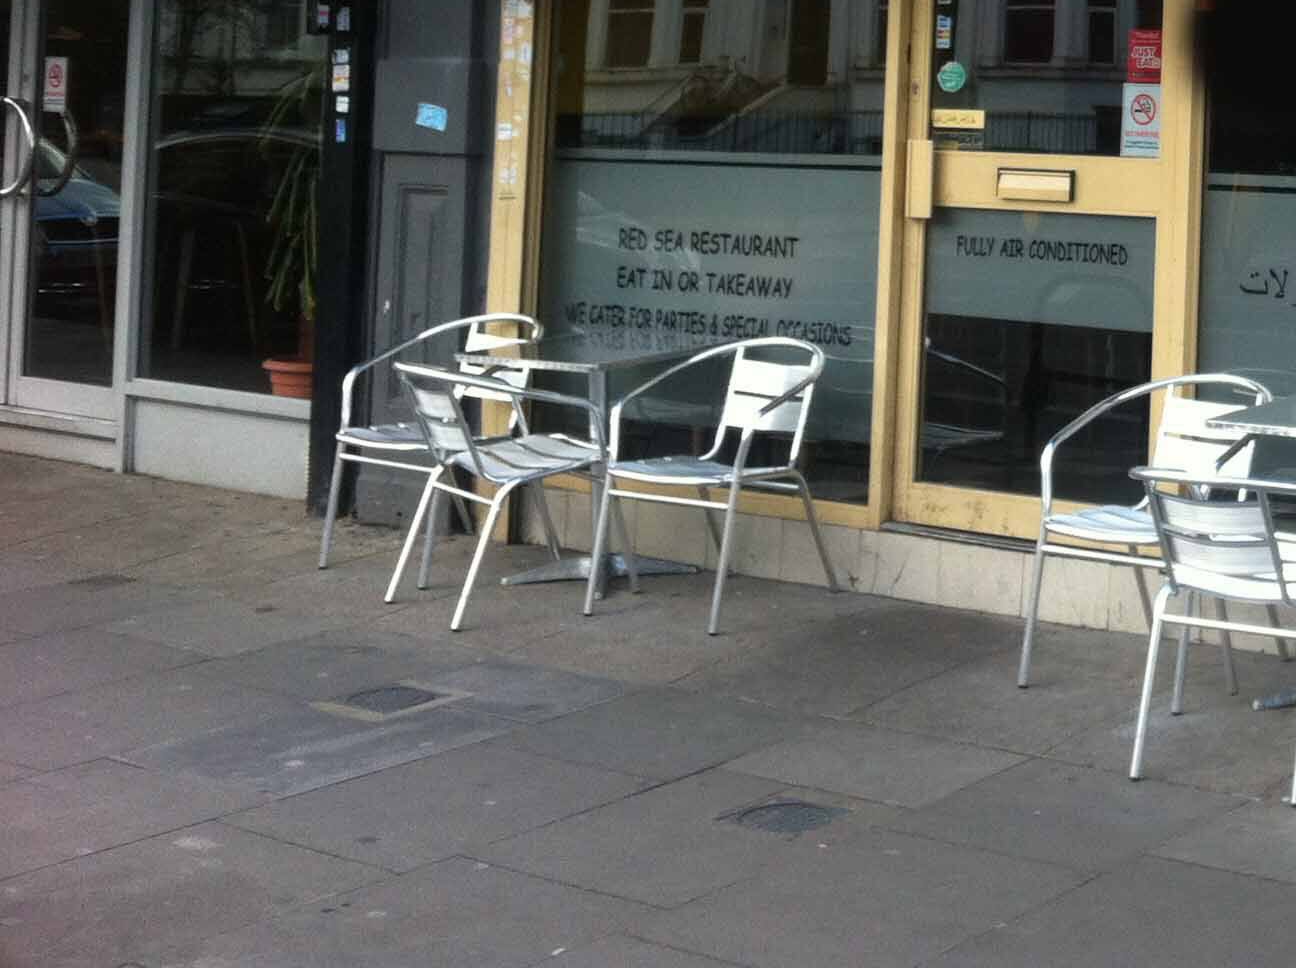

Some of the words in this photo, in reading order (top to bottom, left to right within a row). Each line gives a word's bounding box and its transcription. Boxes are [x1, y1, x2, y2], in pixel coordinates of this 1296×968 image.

[617, 228, 648, 250] RED
[654, 230, 685, 253] SEA
[690, 232, 799, 259] RESTAURANT
[956, 235, 994, 258] FULLY
[1000, 239, 1024, 257] AIR
[1028, 239, 1129, 266] CONDITIONED
[616, 266, 647, 290] EAT
[652, 268, 673, 291] IN
[678, 270, 700, 293] OR
[705, 272, 794, 300] TAKEAWAY
[589, 304, 625, 327] CATER
[629, 306, 650, 328] FOR
[655, 308, 705, 335] PARTIES
[724, 313, 769, 338] SPECIAL
[776, 318, 852, 346] OCCASIONS
